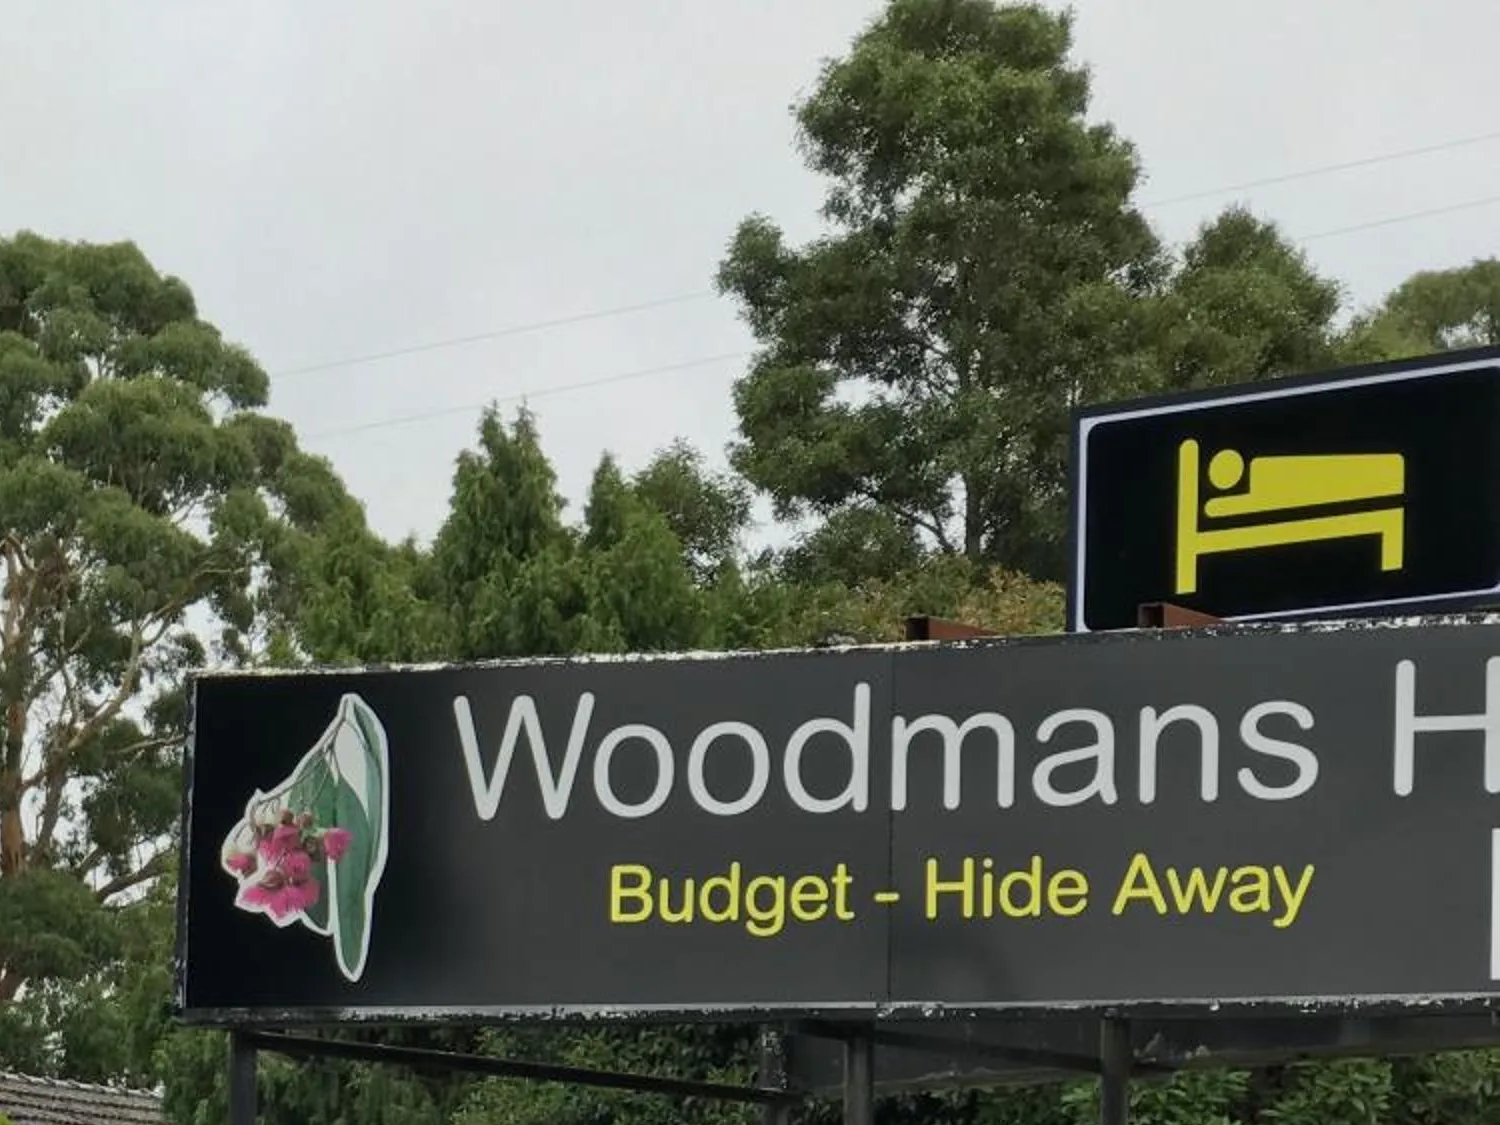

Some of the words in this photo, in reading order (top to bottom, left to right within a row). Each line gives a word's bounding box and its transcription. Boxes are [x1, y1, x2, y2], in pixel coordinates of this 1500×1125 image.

[453, 682, 1319, 821] Woodmans
[610, 863, 852, 937] Budget
[925, 855, 1089, 920] Hide
[1111, 852, 1315, 929] Away
